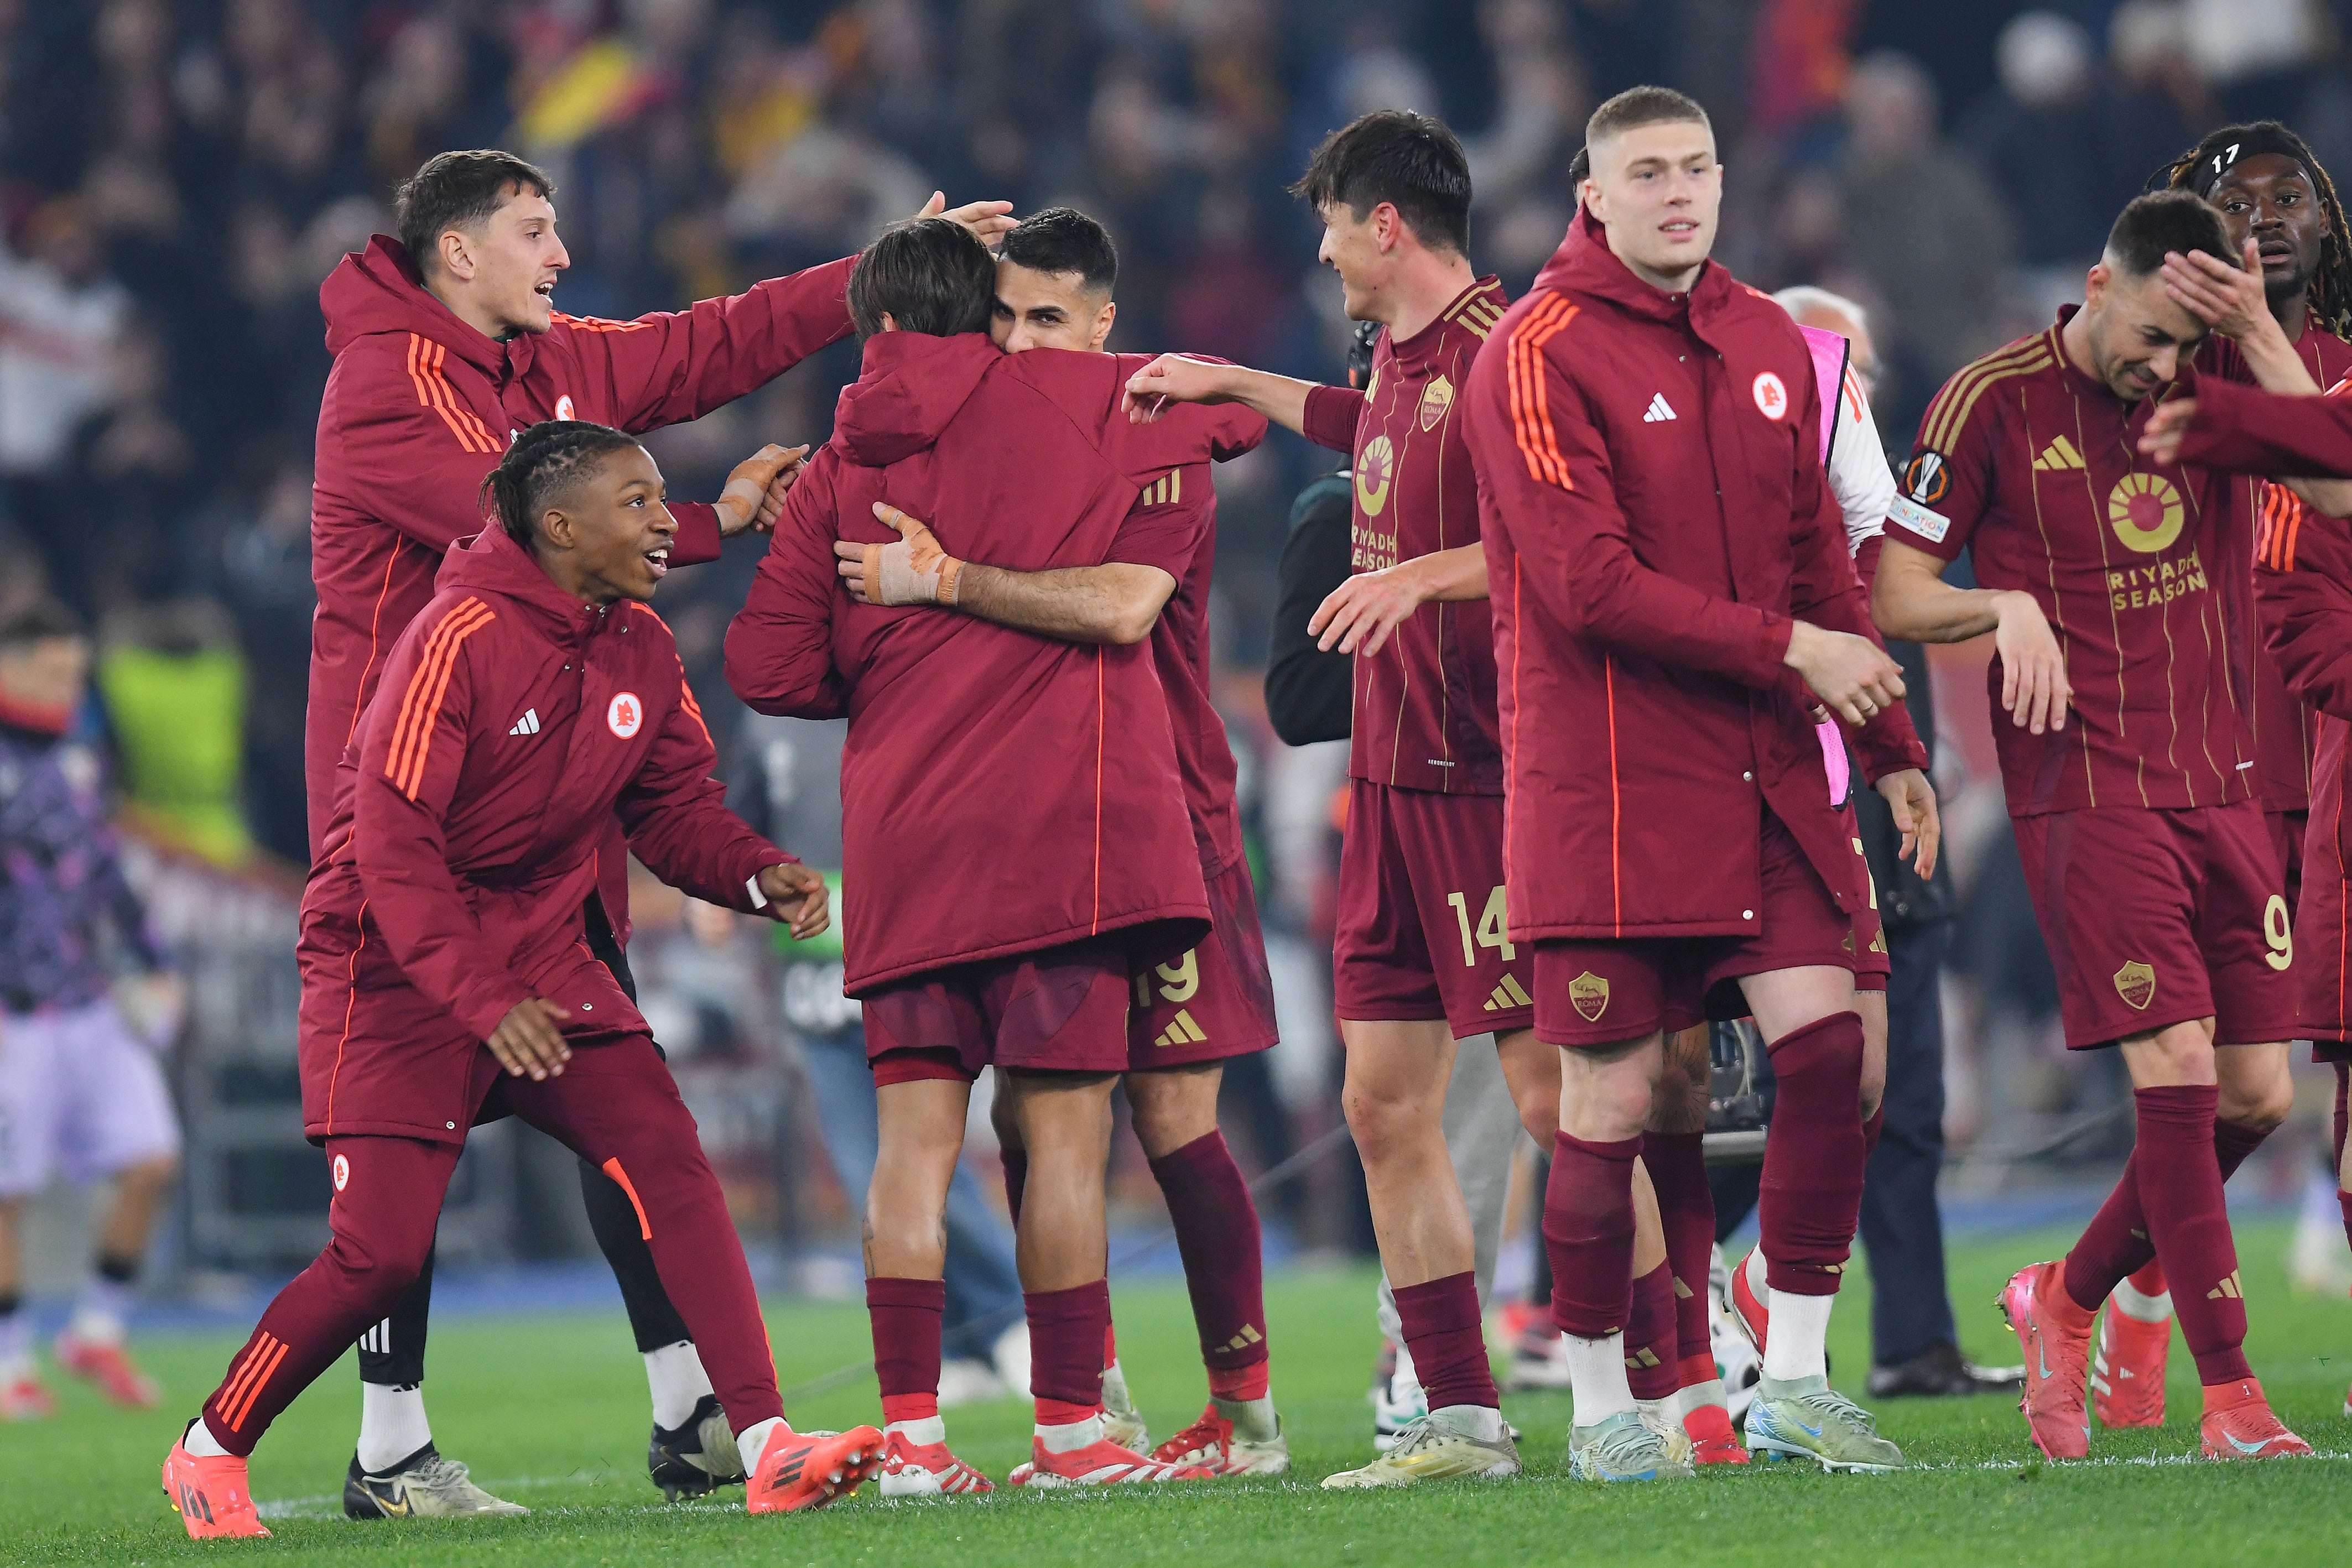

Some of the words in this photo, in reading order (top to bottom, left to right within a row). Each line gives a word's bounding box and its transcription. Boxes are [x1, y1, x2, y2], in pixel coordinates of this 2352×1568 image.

[2211, 143, 2240, 174] 17
[1351, 547, 1395, 570] EASON
[2109, 550, 2199, 590] RIYADH
[2114, 572, 2206, 610] SEASON
[1448, 885, 1516, 967] 14
[2264, 894, 2293, 971] 9
